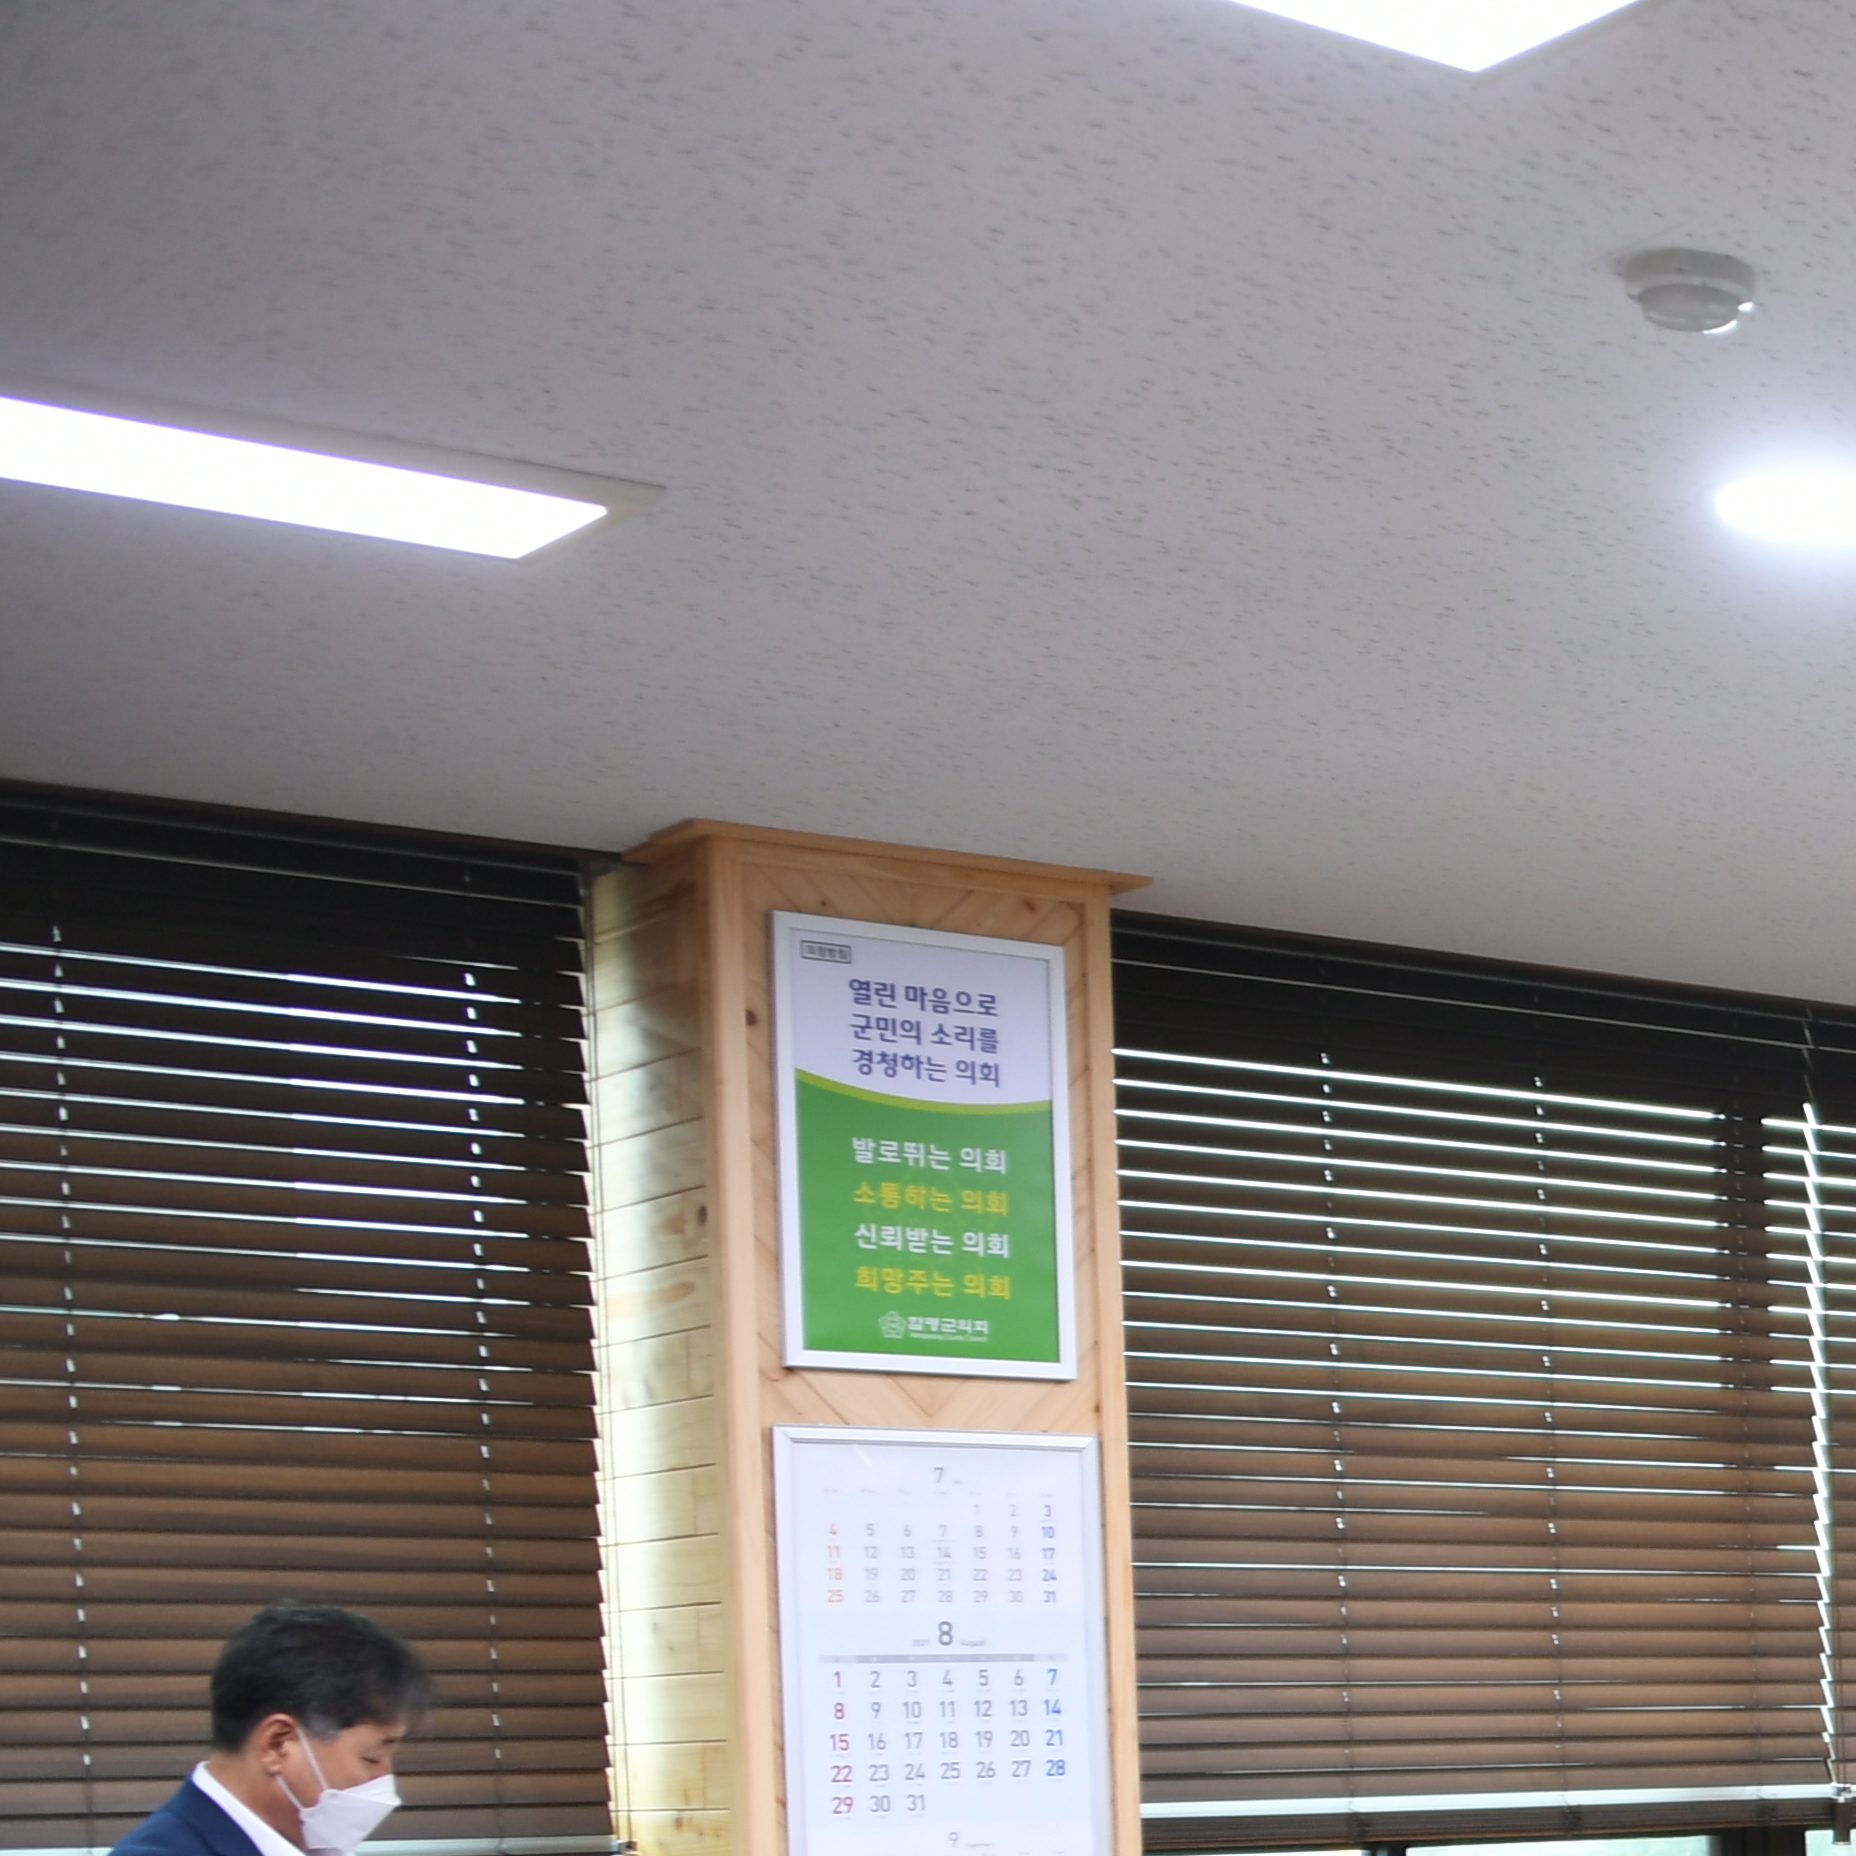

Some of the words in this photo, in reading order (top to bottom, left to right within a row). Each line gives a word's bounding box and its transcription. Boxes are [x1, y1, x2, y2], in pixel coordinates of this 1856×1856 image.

[849, 978, 896, 1009] 열린
[905, 985, 999, 1017] 마음으로
[850, 1014, 921, 1045] 군민의
[930, 1023, 999, 1054] 소리를
[852, 1049, 947, 1082] 경청하는
[955, 1060, 1000, 1087] 의회
[852, 1137, 952, 1170] 발로뛰는
[960, 1147, 1007, 1174] 의회
[854, 1181, 952, 1212] 소통하는
[960, 1190, 1009, 1216] 의회
[855, 1223, 954, 1255] 신뢰받는
[962, 1232, 1009, 1258] 의회
[855, 1266, 954, 1297] 희망주는
[963, 1274, 1011, 1300] 의회
[933, 1467, 944, 1484] 7
[973, 1503, 980, 1516] 1
[1009, 1504, 1018, 1517] 2
[1044, 1504, 1052, 1517] 3
[829, 1523, 837, 1535] 4
[866, 1523, 875, 1537] 5
[903, 1524, 912, 1537] 6
[939, 1524, 948, 1537] 7
[975, 1525, 983, 1538] 8
[1010, 1526, 1018, 1538] 9
[1042, 1526, 1055, 1539] 10
[827, 1545, 840, 1558] 11
[864, 1545, 877, 1559] 12
[901, 1546, 915, 1559] 13
[937, 1547, 951, 1559] 14
[973, 1547, 986, 1560] 15
[1008, 1548, 1021, 1560] 16
[1042, 1548, 1055, 1560] 17
[827, 1568, 842, 1580] 18
[865, 1568, 878, 1581] 19
[901, 1568, 916, 1581] 20
[937, 1568, 951, 1581] 21
[973, 1569, 988, 1582] 22
[1008, 1569, 1022, 1582] 23
[1042, 1569, 1057, 1582] 24
[827, 1590, 843, 1603] 25
[865, 1590, 880, 1603] 26
[901, 1590, 916, 1603] 27
[938, 1590, 953, 1603] 28
[974, 1590, 988, 1603] 29
[1009, 1590, 1023, 1603] 30
[1043, 1590, 1056, 1603] 31
[938, 1621, 953, 1646] 8
[834, 1671, 841, 1688] 1
[870, 1671, 880, 1688] 2
[907, 1671, 917, 1687] 3
[942, 1670, 953, 1686] 4
[979, 1669, 989, 1686] 5
[1014, 1669, 1024, 1686] 6
[1048, 1669, 1058, 1686] 7
[834, 1702, 845, 1720] 8
[871, 1702, 881, 1719] 9
[903, 1702, 921, 1718] 10
[939, 1701, 956, 1717] 11
[974, 1700, 992, 1717] 12
[1010, 1699, 1028, 1716] 13
[1043, 1699, 1062, 1716] 14
[829, 1734, 850, 1751] 15
[868, 1733, 886, 1750] 16
[905, 1732, 923, 1749] 17
[940, 1732, 959, 1748] 18
[975, 1731, 993, 1748] 19
[1010, 1730, 1030, 1747] 20
[1045, 1729, 1063, 1746] 21
[831, 1765, 853, 1783] 22
[869, 1764, 890, 1781] 23
[904, 1764, 926, 1780] 24
[940, 1762, 961, 1779] 25
[976, 1761, 996, 1778] 26
[1012, 1760, 1031, 1777] 27
[1046, 1759, 1066, 1777] 28
[832, 1797, 854, 1815] 29
[869, 1796, 891, 1812] 30
[907, 1794, 926, 1811] 31
[948, 1832, 959, 1847] 9
